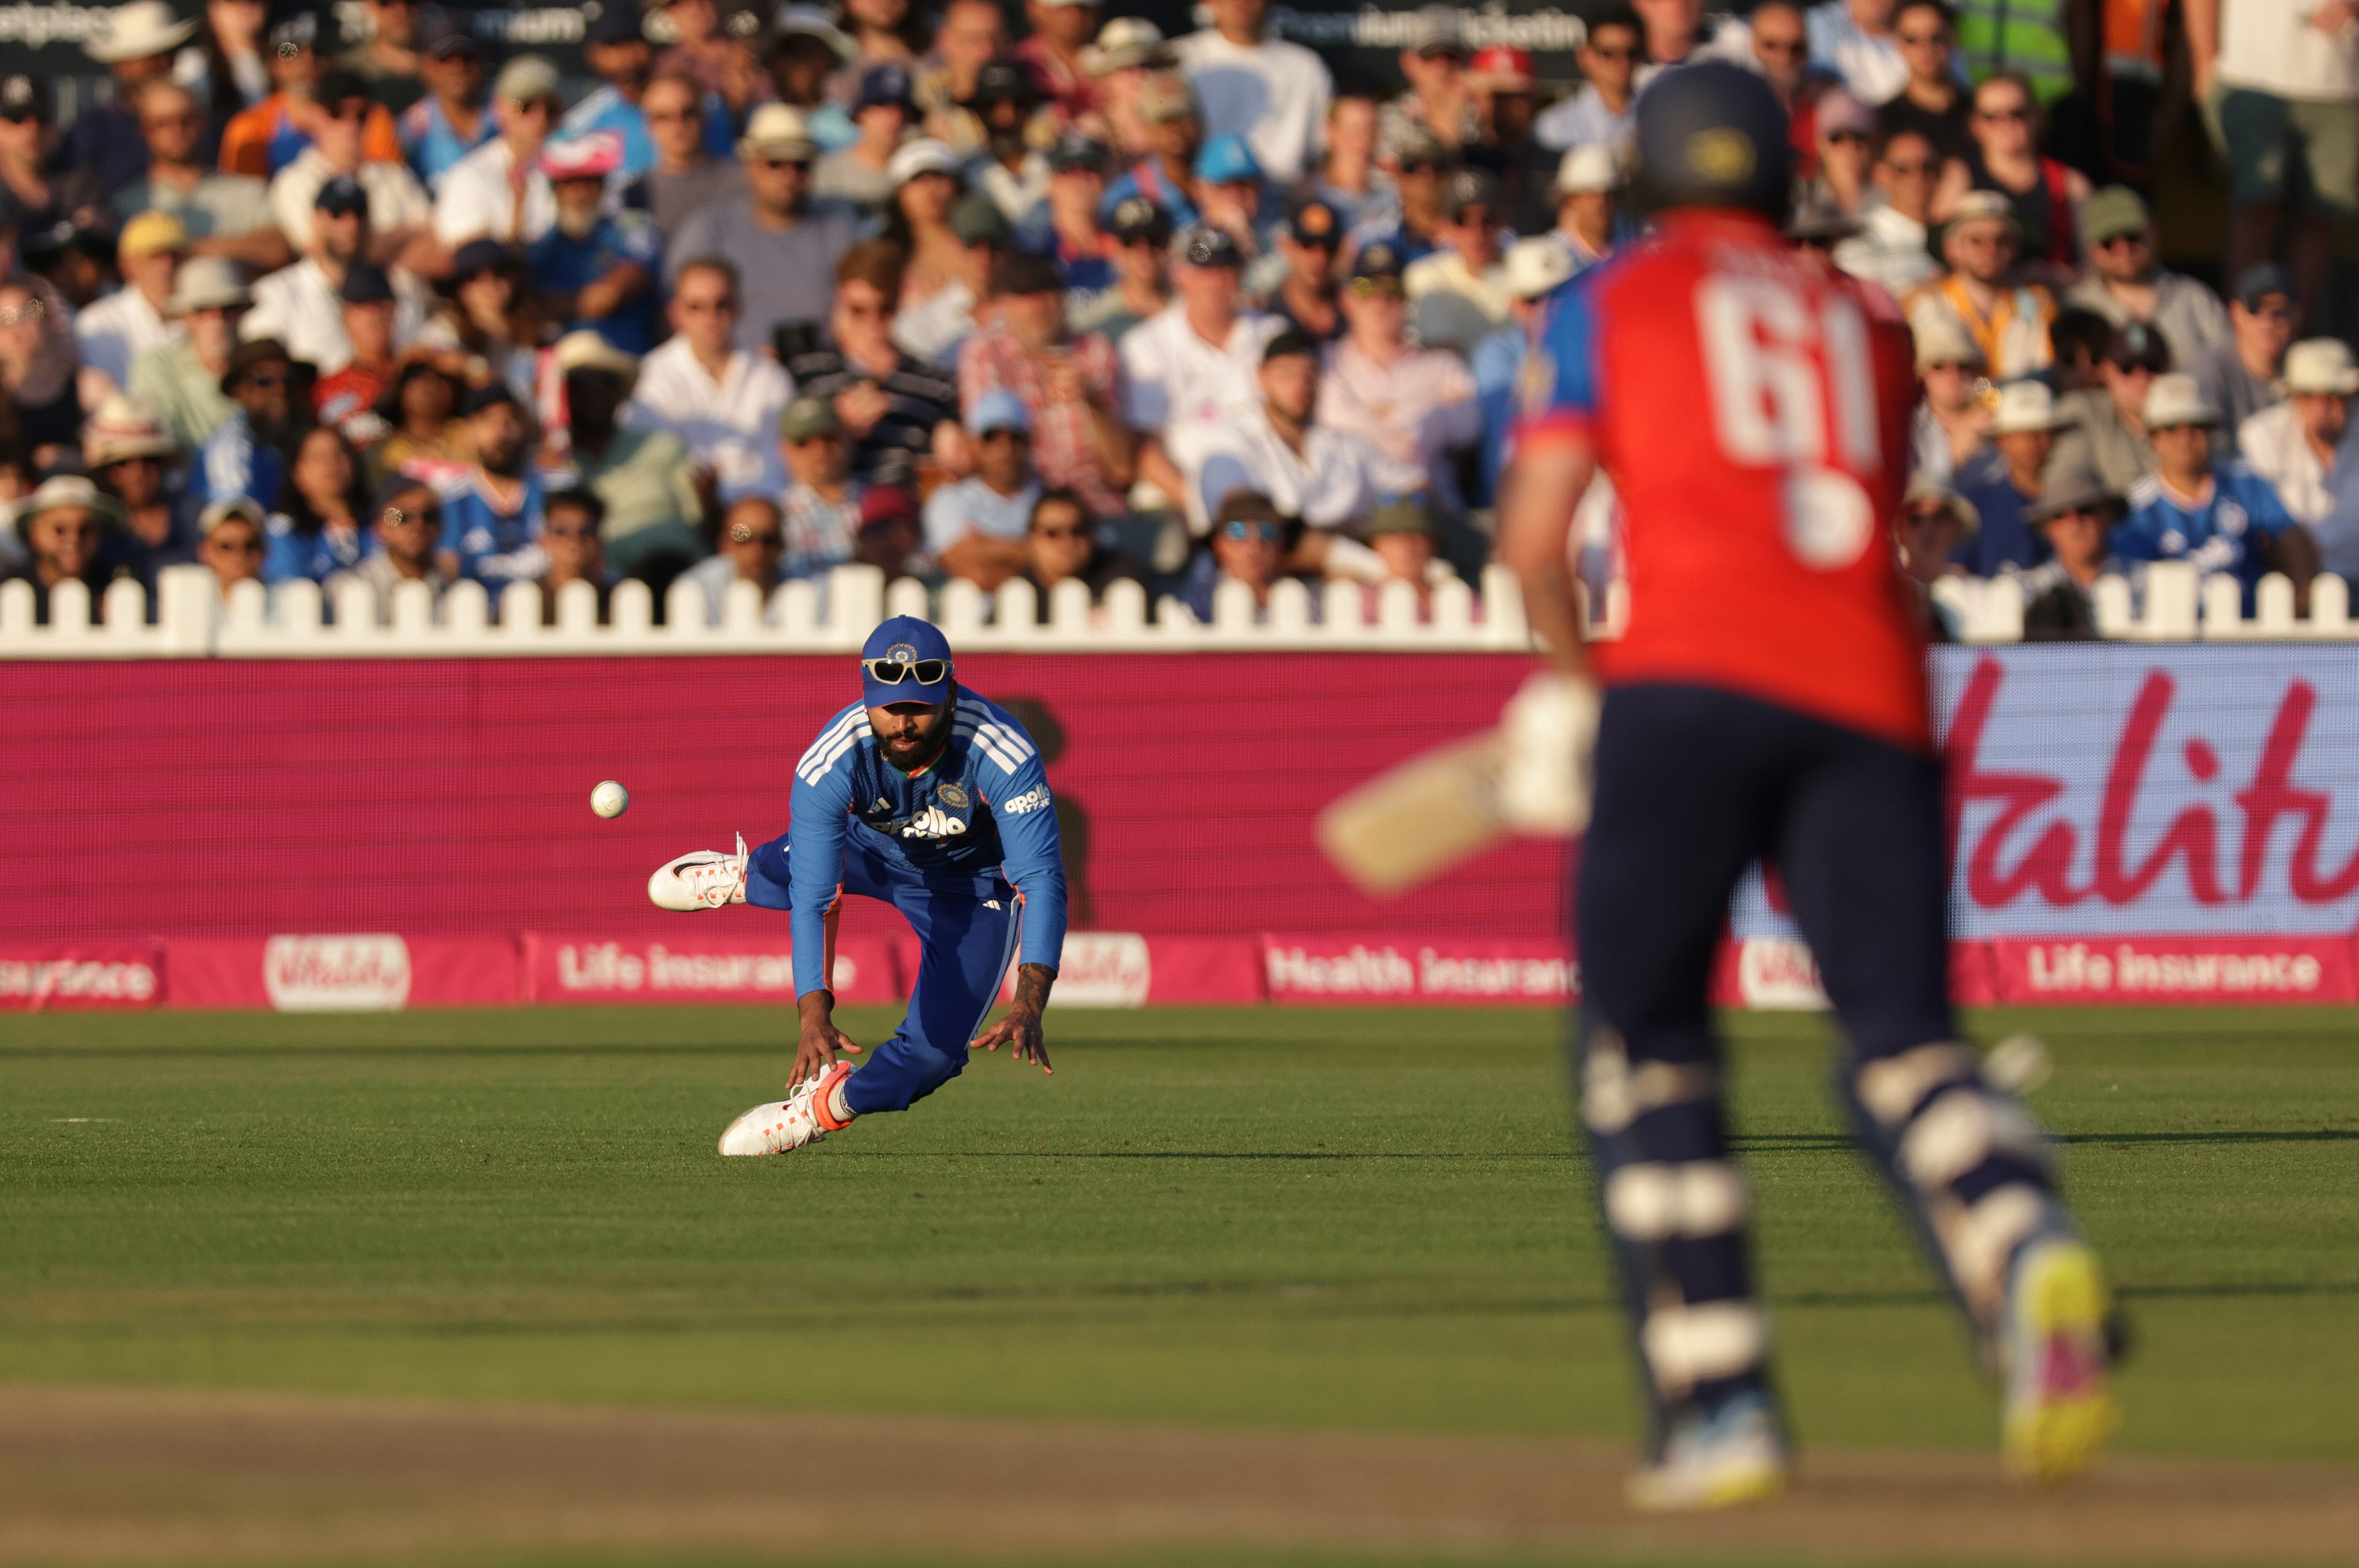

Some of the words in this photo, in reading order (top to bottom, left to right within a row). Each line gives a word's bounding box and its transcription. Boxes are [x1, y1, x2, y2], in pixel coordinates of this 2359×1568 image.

[1693, 270, 1885, 474] 61
[1005, 782, 1050, 814] apollo
[558, 941, 643, 990] Life
[1267, 944, 1413, 994] Health
[2028, 942, 2112, 993] Life
[2117, 943, 2322, 993] insurance
